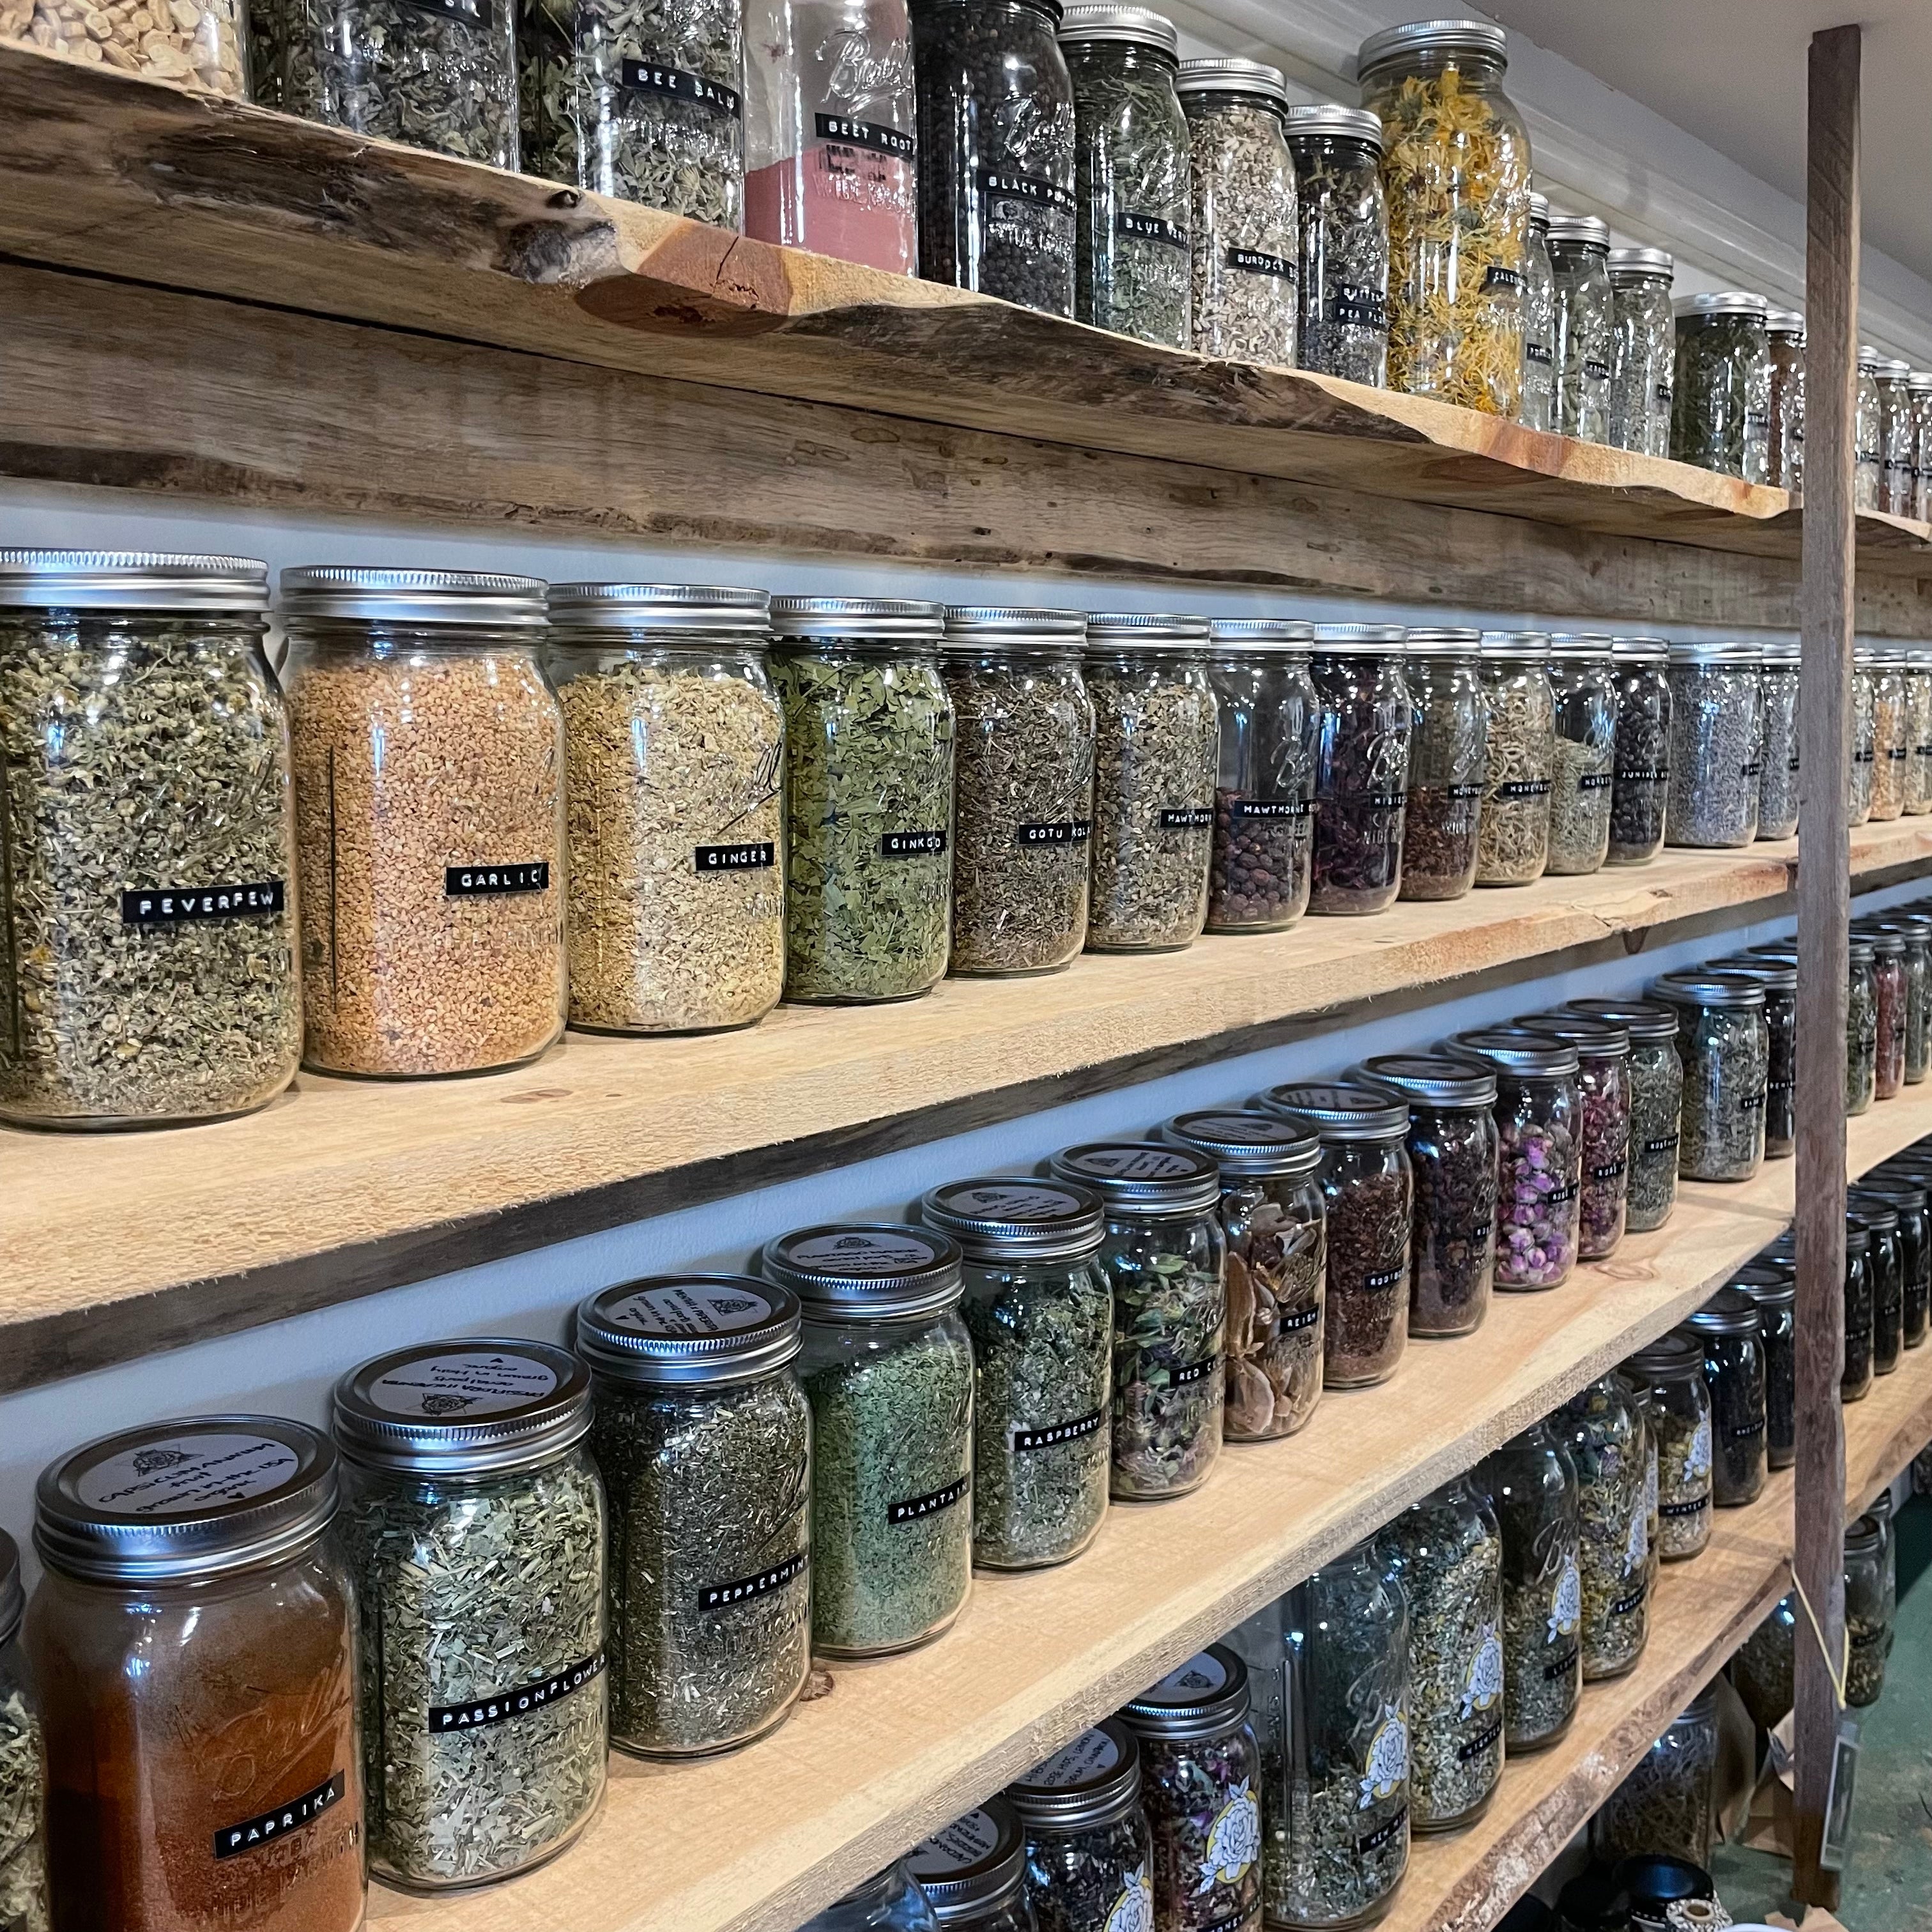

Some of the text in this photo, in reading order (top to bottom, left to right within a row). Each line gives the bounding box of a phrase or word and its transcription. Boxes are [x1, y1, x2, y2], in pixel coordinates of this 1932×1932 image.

[638, 68, 735, 109] BEE BALM
[829, 121, 911, 151] BEET ROOT
[988, 175, 1037, 196] BLACK
[1125, 217, 1160, 234] BLUE
[1339, 308, 1361, 321] PEA
[891, 838, 941, 850] GINKGO
[1029, 828, 1063, 839] GOTU
[708, 850, 767, 865] GINGER
[461, 869, 539, 887] GARLIC
[139, 891, 274, 915] FEVERFEW
[1179, 1368, 1199, 1381] RED
[1024, 1416, 1099, 1446] RASPBERRY
[897, 1481, 968, 1518] PLANTAIN
[709, 1554, 809, 1604] PEPPERMINT
[442, 1653, 606, 1726] PASSIONFLOWER
[229, 1786, 335, 1847] PAPRIKA
